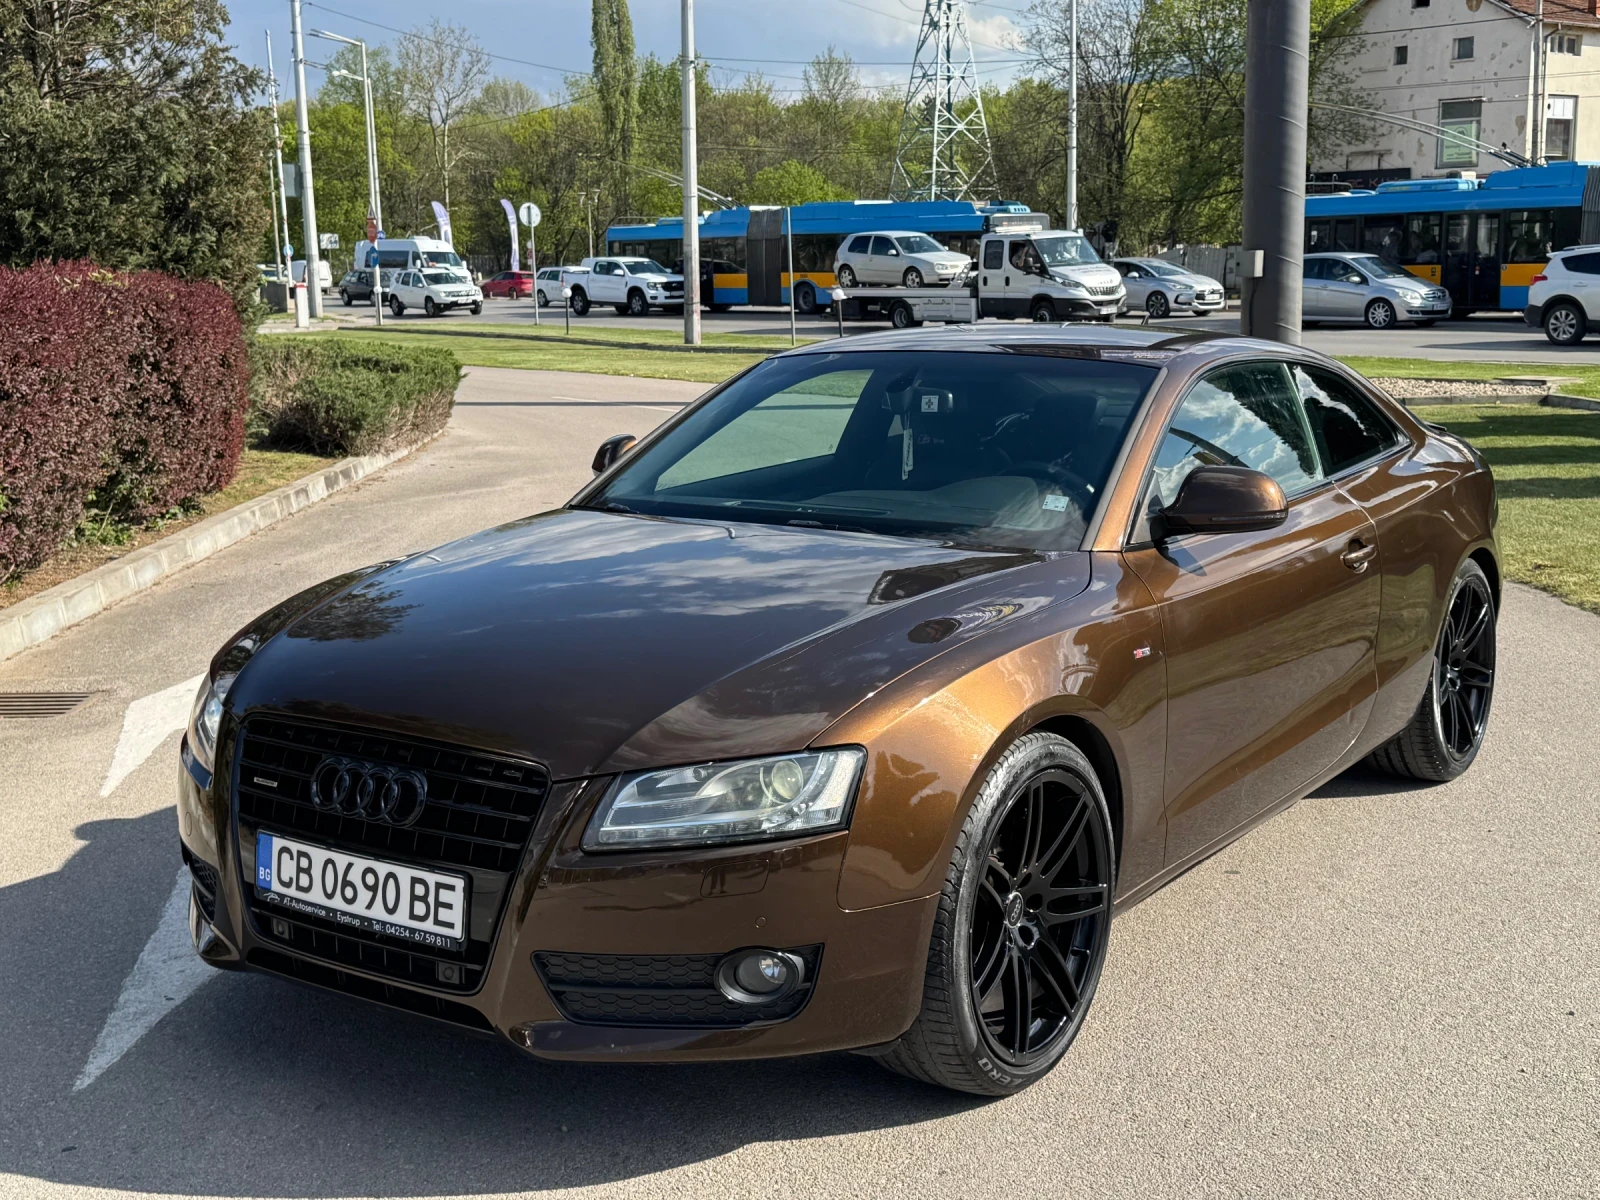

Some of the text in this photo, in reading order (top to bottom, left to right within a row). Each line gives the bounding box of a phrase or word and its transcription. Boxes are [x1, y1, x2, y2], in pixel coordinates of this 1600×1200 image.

[259, 867, 271, 881] BG
[276, 846, 457, 930] CB 0690 BE
[283, 897, 326, 917] AT-Autoservice
[337, 911, 361, 927] Eystrup
[372, 921, 384, 932] Tel:
[977, 1057, 1027, 1086] ZERO
